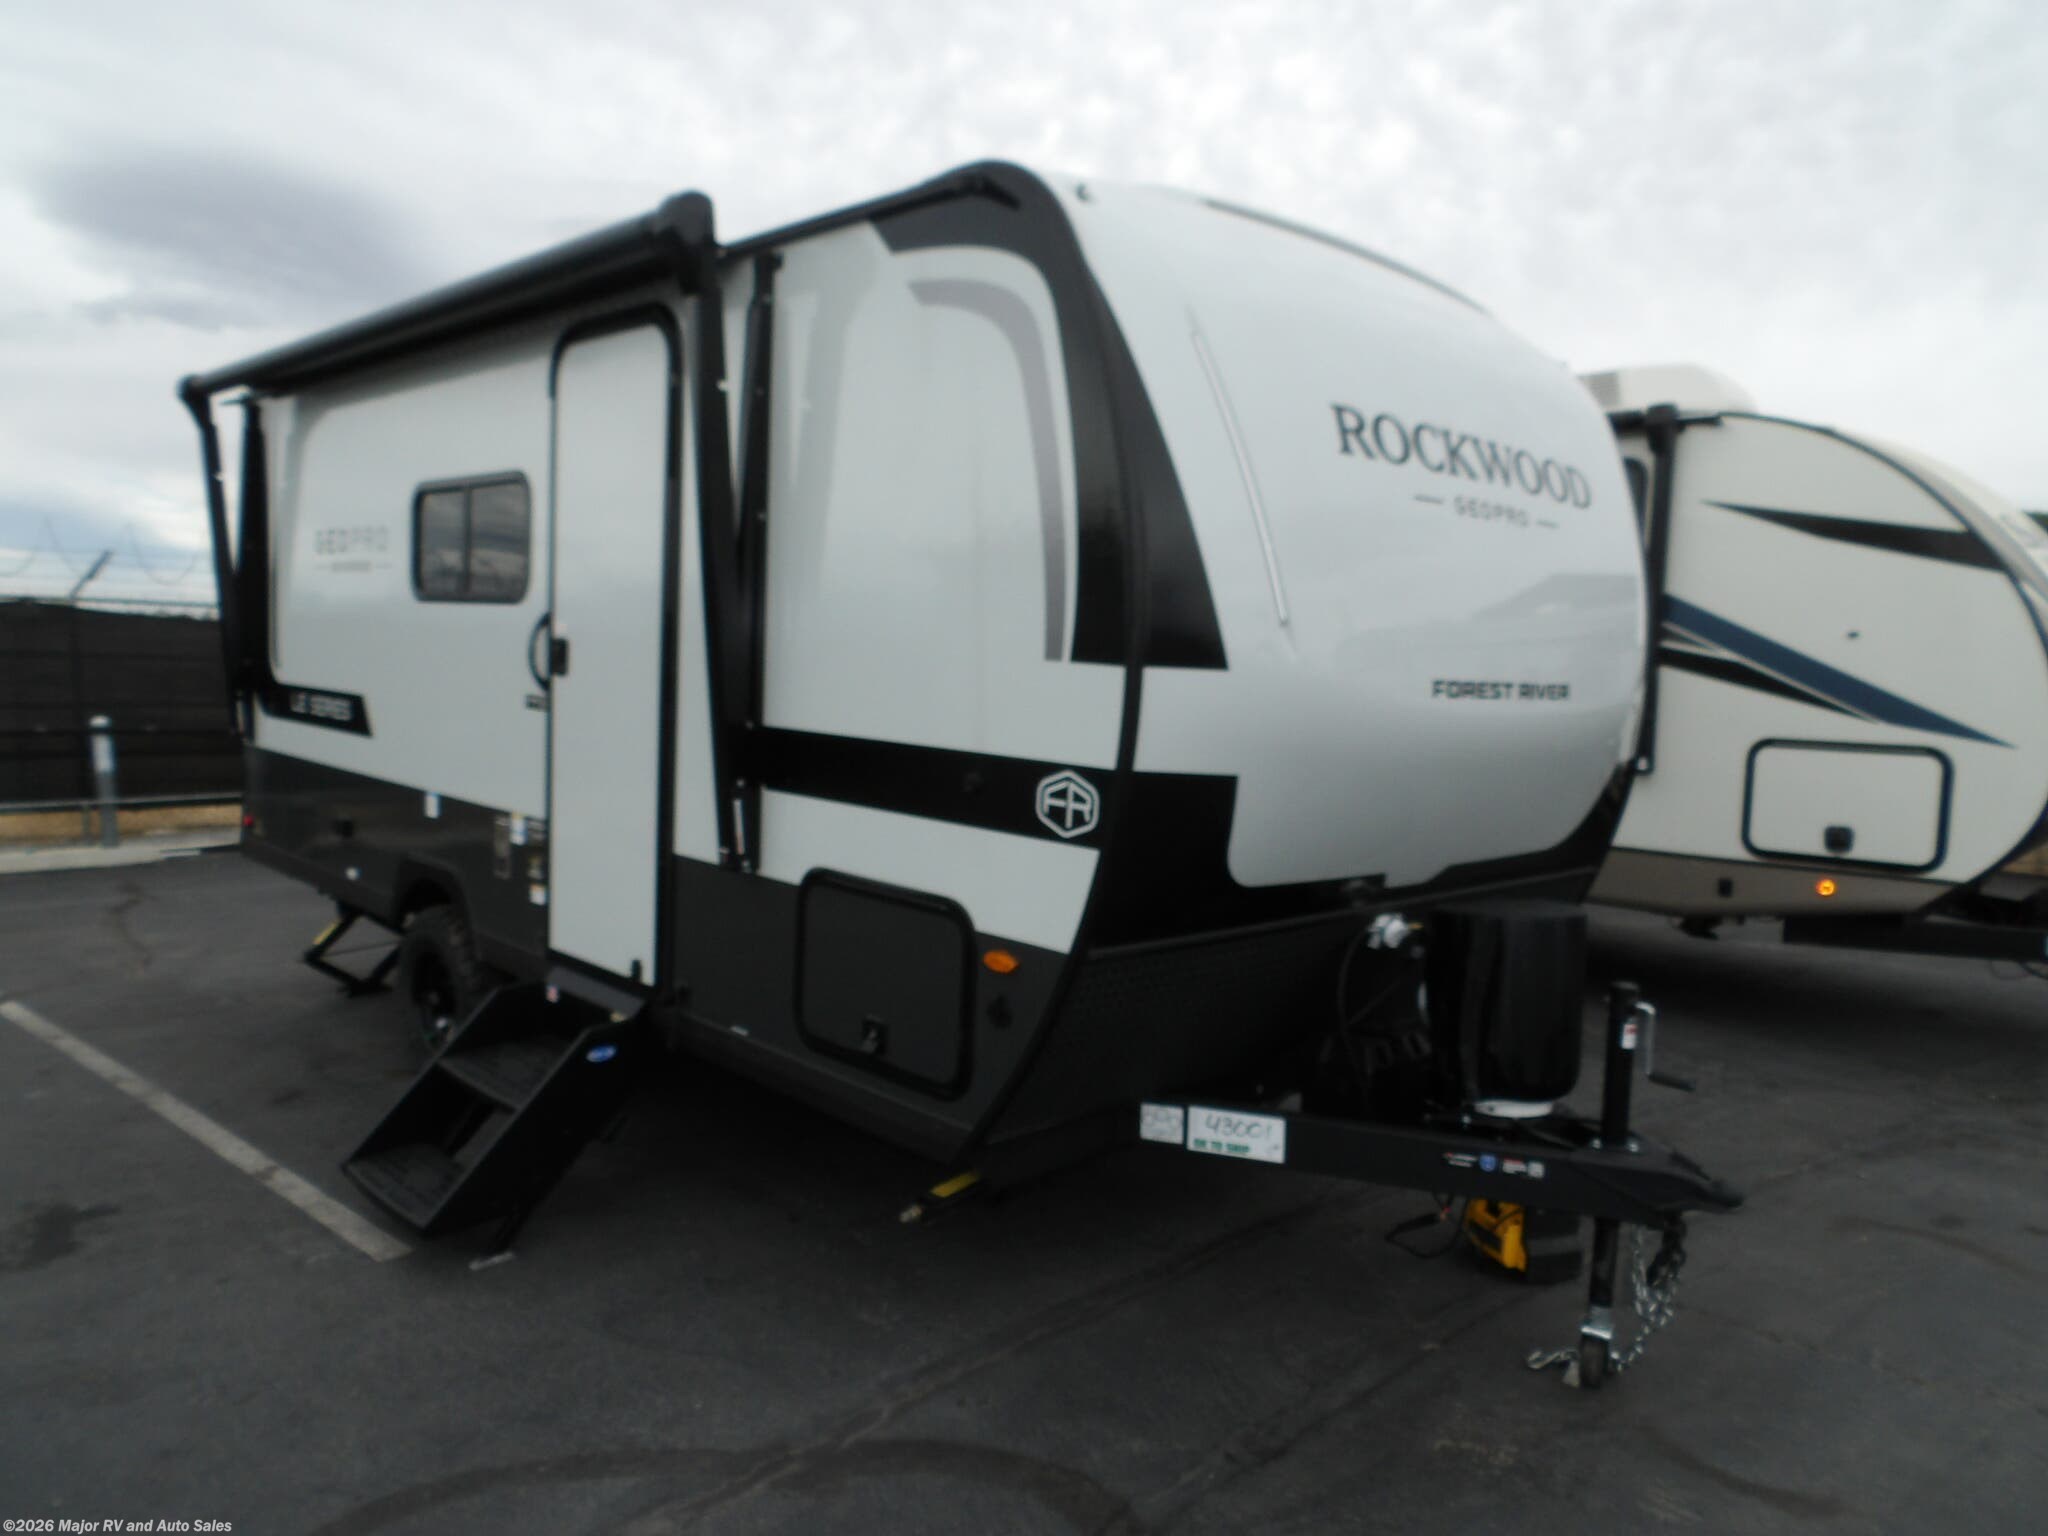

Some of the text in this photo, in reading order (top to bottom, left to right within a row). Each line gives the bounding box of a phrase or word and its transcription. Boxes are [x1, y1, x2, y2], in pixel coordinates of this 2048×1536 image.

[1331, 402, 1593, 509] ROCKWOOD
[1432, 679, 1569, 701] FOREST RIVER
